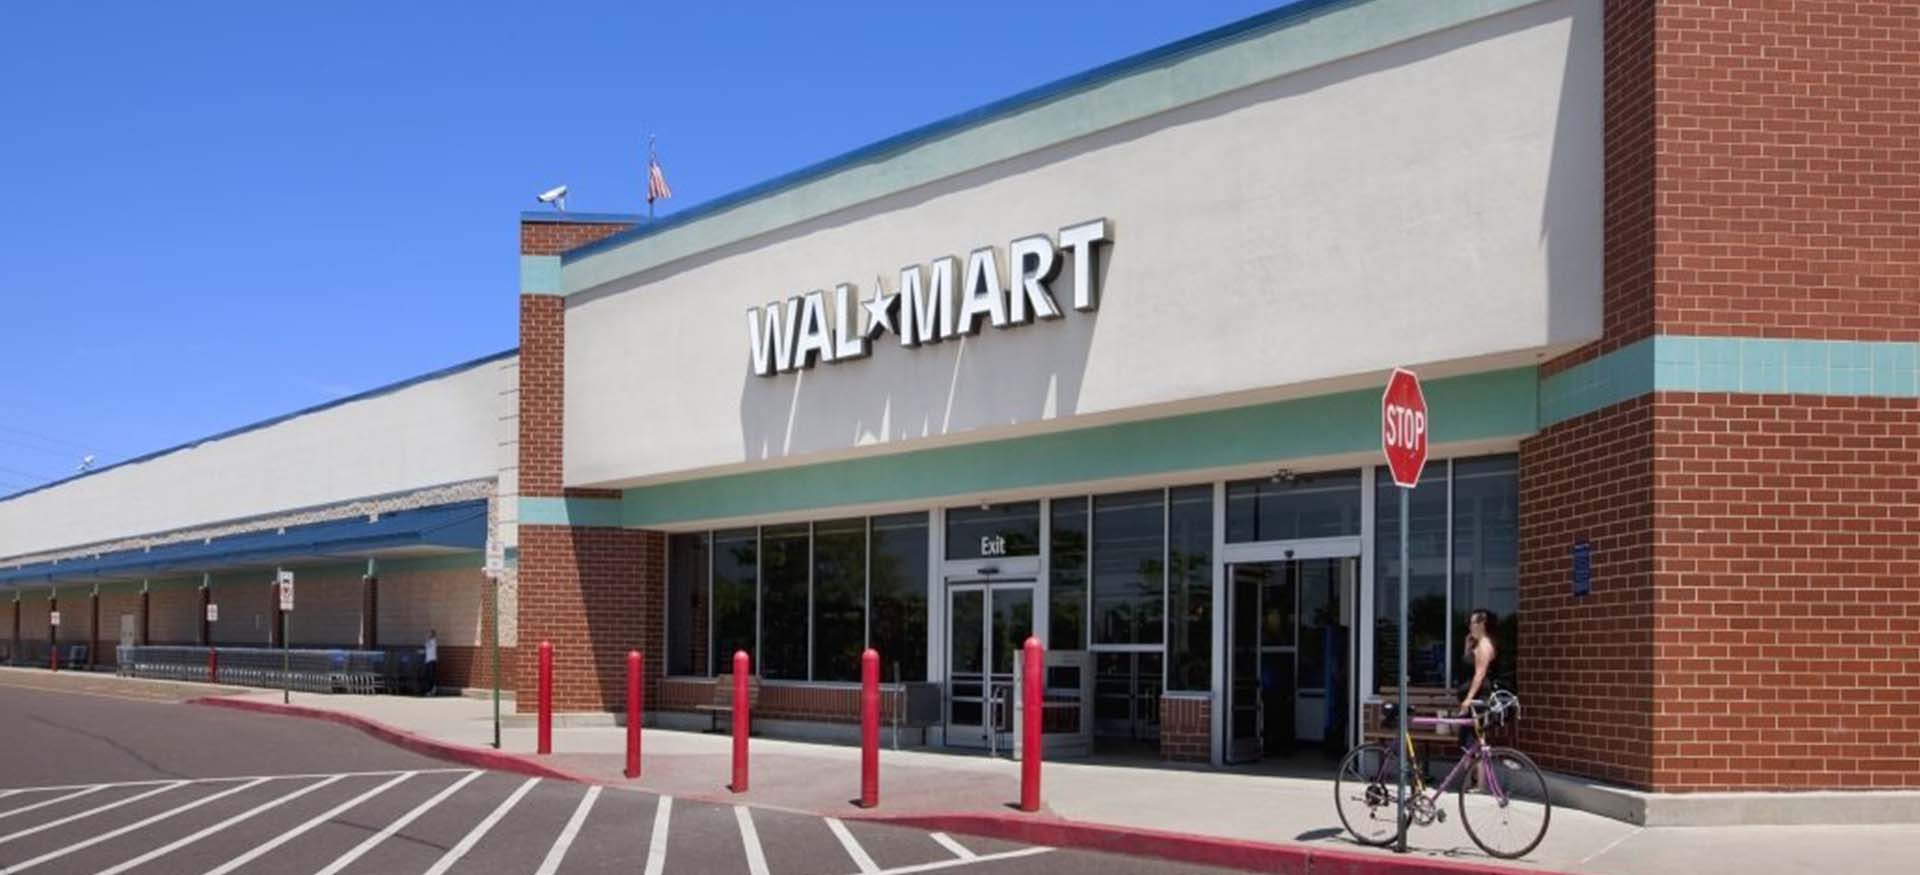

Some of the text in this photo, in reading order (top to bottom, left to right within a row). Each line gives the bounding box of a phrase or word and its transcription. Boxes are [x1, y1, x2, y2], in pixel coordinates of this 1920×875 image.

[899, 218, 1110, 348] MART
[1386, 404, 1424, 450] STOP
[981, 535, 1006, 555] Exit
